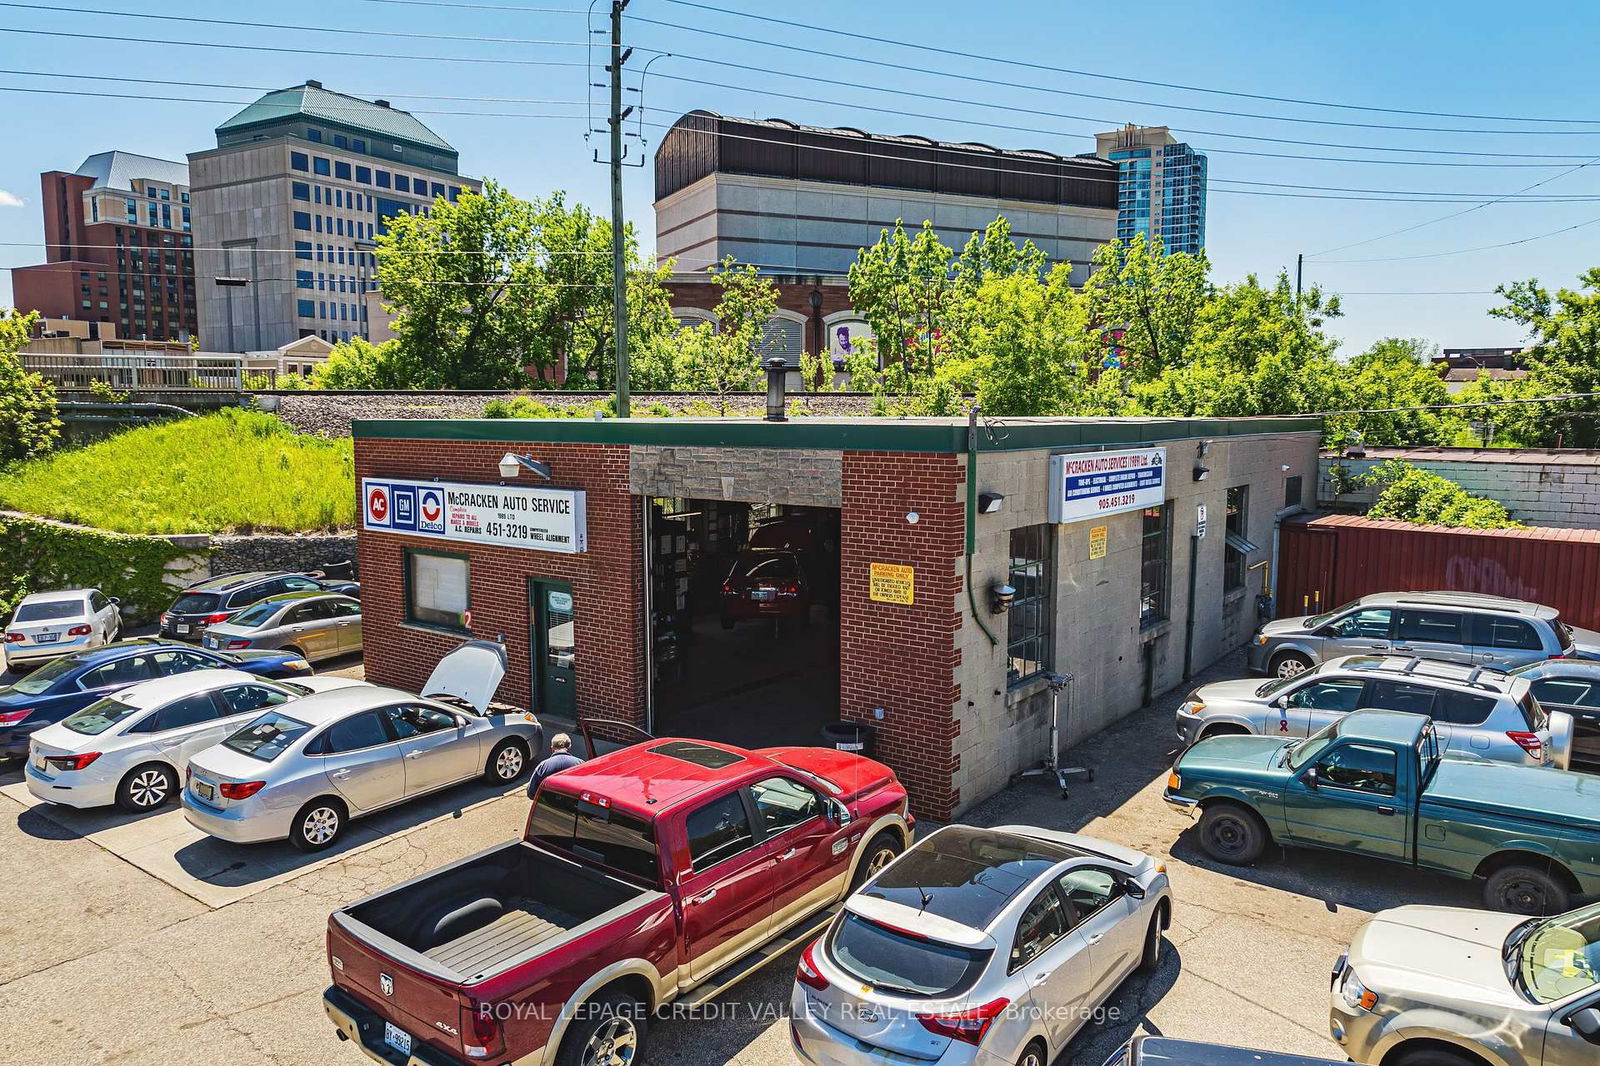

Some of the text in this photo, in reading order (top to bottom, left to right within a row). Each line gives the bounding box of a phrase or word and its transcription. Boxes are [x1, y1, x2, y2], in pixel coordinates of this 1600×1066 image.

[1095, 458, 1108, 472] AUTO
[1108, 456, 1128, 470] SERVICES
[373, 497, 385, 511] AC
[399, 499, 410, 512] GM
[448, 492, 570, 514] McCRACKEN AUTO SERVICE
[1099, 494, 1135, 510] 905.451.3219
[421, 521, 443, 530] Delco
[464, 526, 482, 534] REPAIRS
[486, 522, 528, 539] 451-3219
[530, 533, 545, 541] WHEEL
[545, 534, 570, 543] ALIGNMENT
